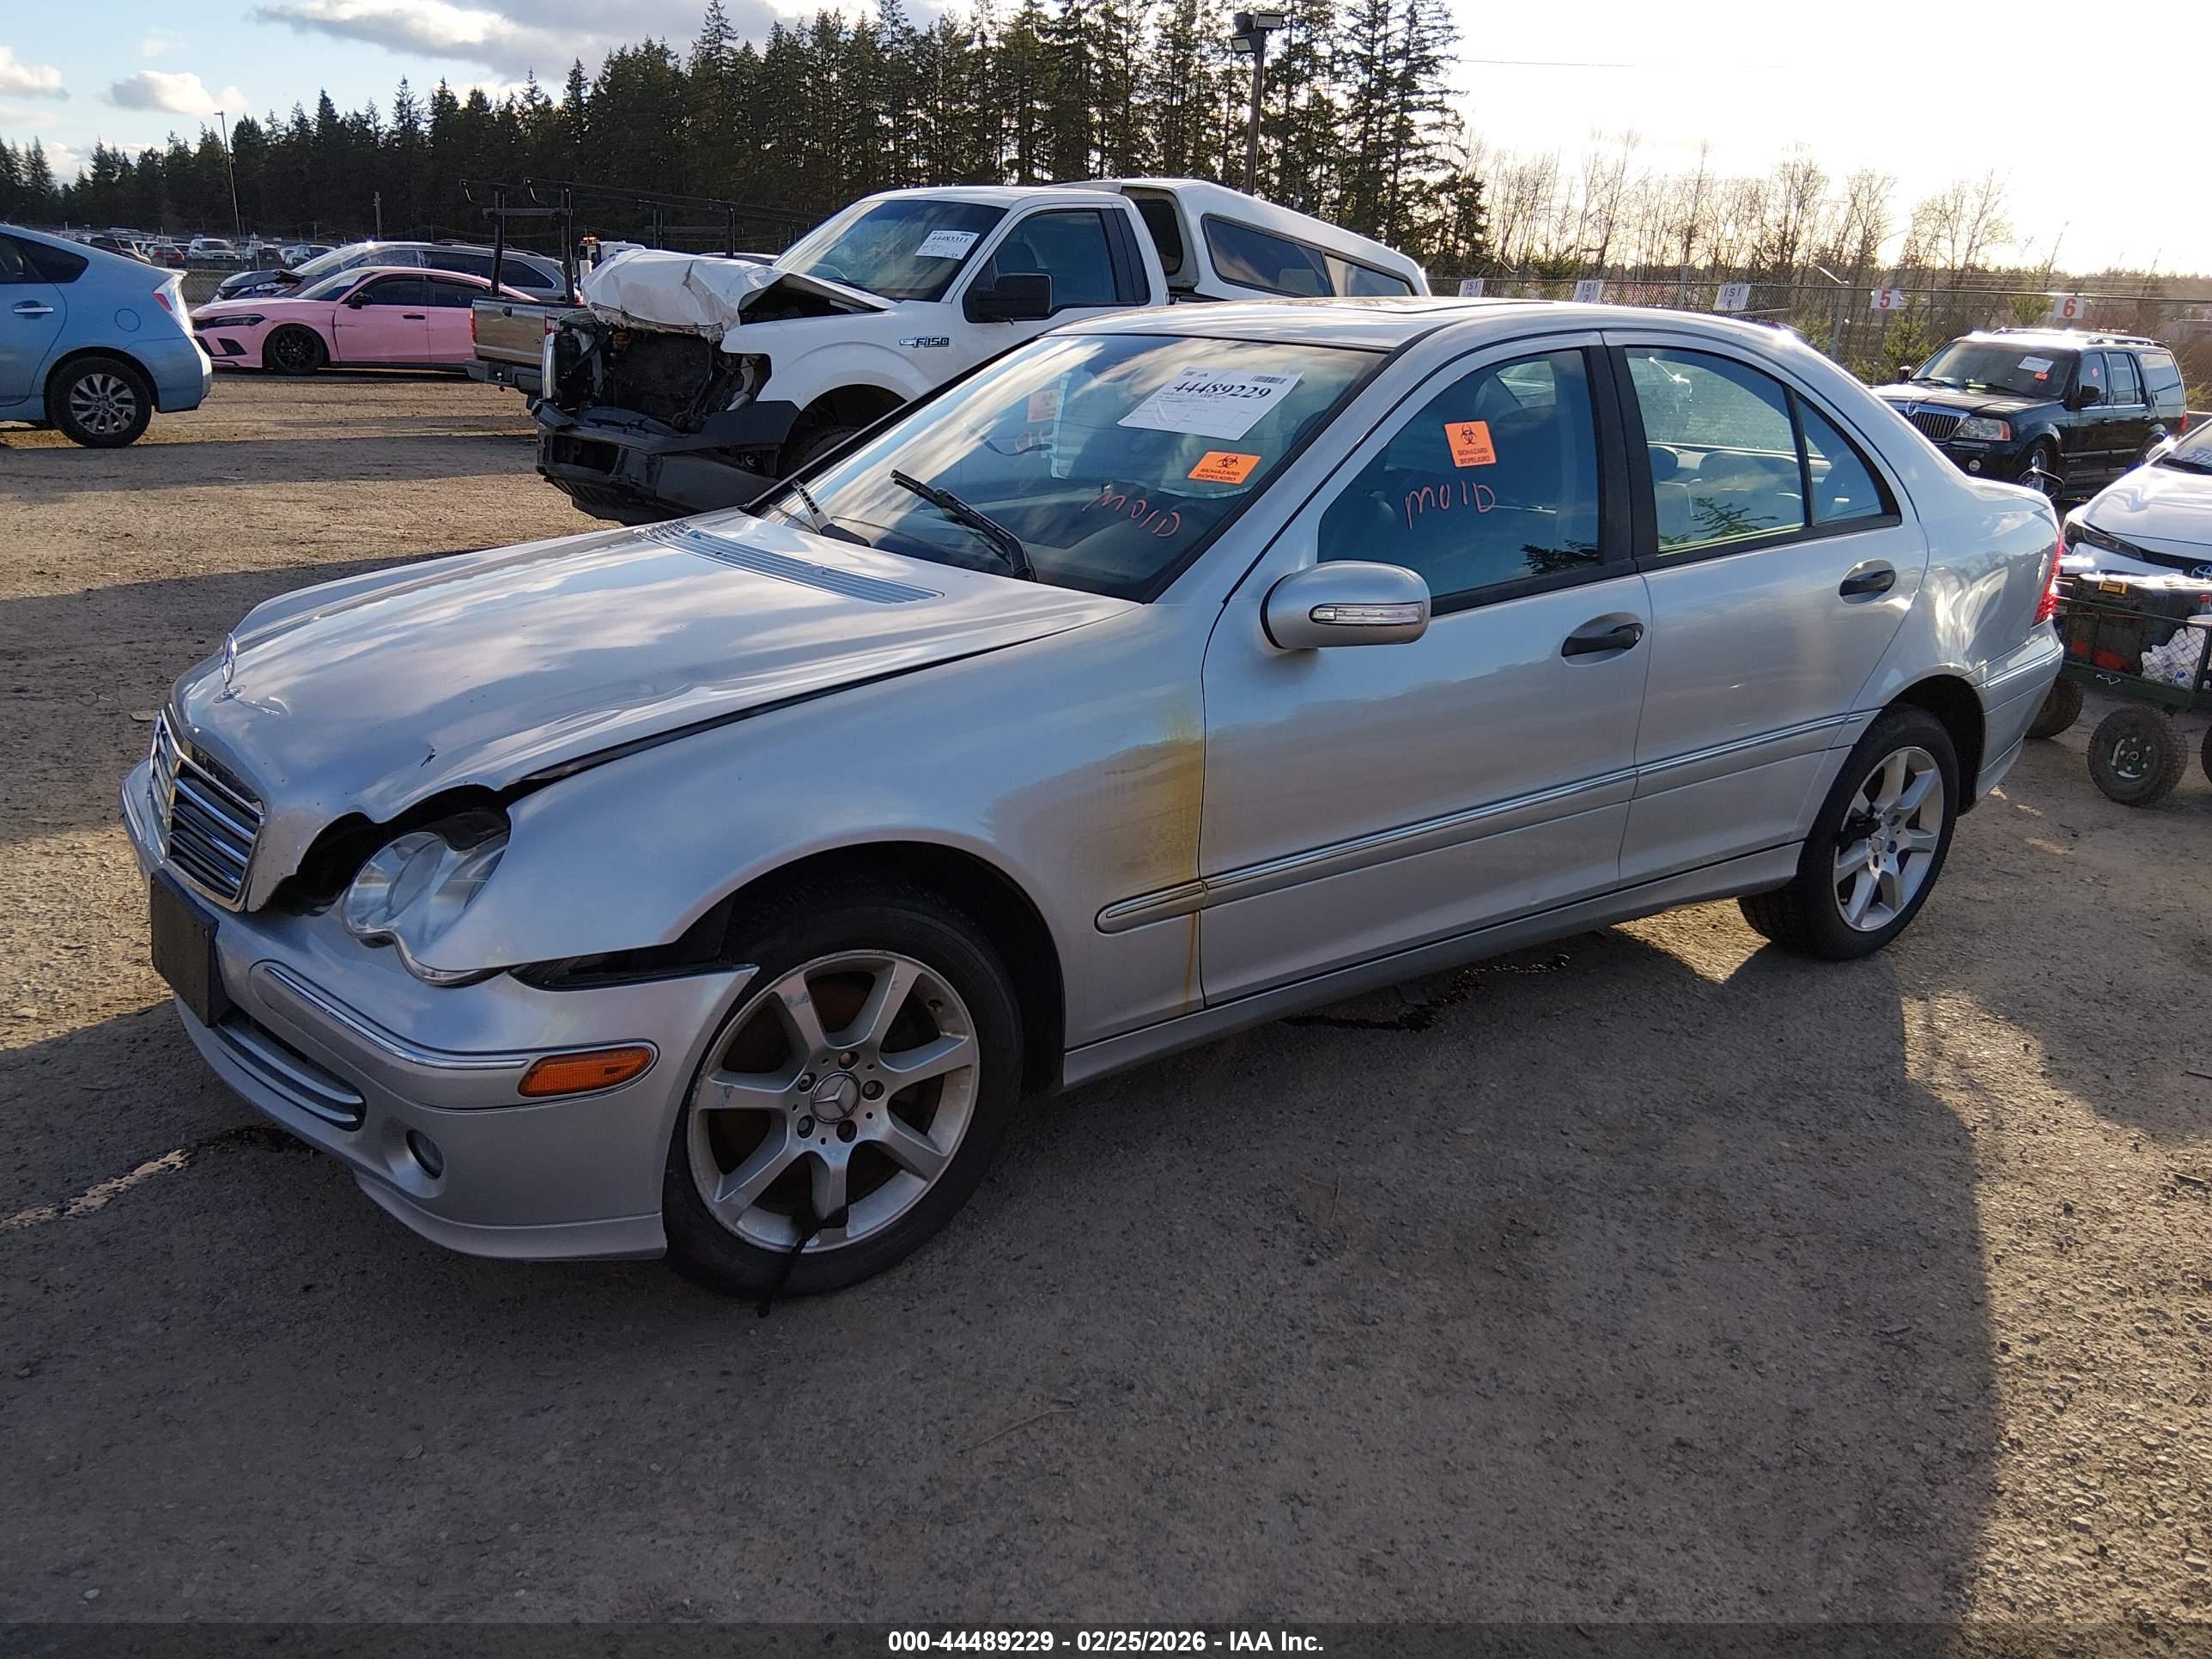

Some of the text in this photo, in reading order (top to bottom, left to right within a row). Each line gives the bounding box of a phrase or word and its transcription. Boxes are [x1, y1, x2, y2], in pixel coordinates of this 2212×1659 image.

[1726, 299, 1732, 309] 4
[1879, 289, 1893, 309] 5
[2063, 297, 2076, 318] 6
[1173, 380, 1272, 399] 44489229
[1457, 447, 1488, 456] BIOHAZARD
[1460, 455, 1491, 465] BIOPELIGRO
[1200, 467, 1241, 477] BIOHAZARD
[1195, 473, 1237, 482] BIOPELIGRO
